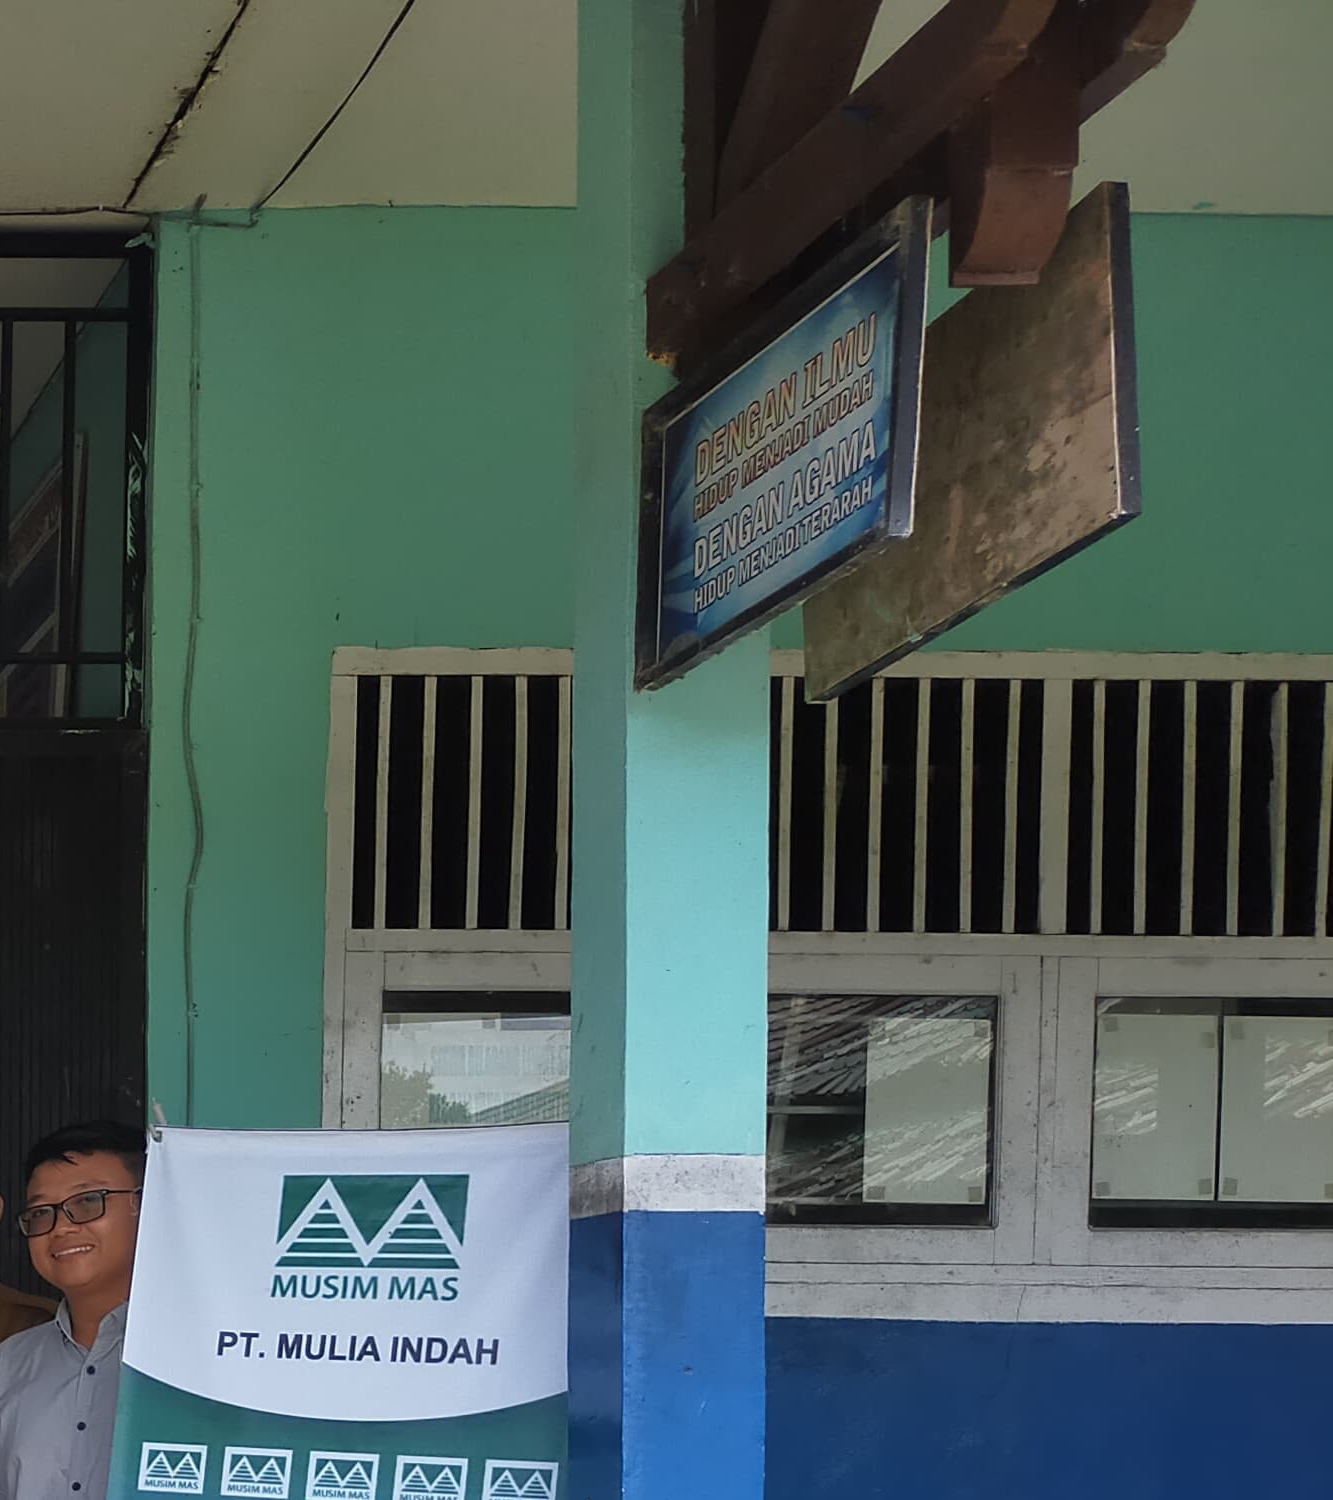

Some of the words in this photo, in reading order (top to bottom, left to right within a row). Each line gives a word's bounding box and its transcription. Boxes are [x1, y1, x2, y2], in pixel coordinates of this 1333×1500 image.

[696, 371, 797, 486] DENGAN
[802, 312, 877, 409] ILMU
[693, 467, 738, 522] HIDUP
[741, 415, 810, 489] MENJADI
[813, 369, 874, 438] MUDAH
[694, 481, 784, 579] DENGAN
[788, 419, 876, 518] AGAMA
[693, 565, 735, 615] HIDUP
[738, 522, 800, 587] MENJADI
[800, 476, 873, 545] TERARAH
[270, 1274, 378, 1300] MUSIM
[388, 1275, 459, 1302] MAS
[217, 1330, 265, 1358] PT.
[277, 1333, 380, 1362] MULIA
[390, 1336, 499, 1366] INDAH
[144, 1478, 176, 1488] MUSIM
[177, 1480, 199, 1489] MAS
[227, 1484, 261, 1493] MUSIM
[263, 1486, 285, 1494] MAS
[312, 1489, 347, 1499] MUSIM
[348, 1491, 371, 1500] MAS
